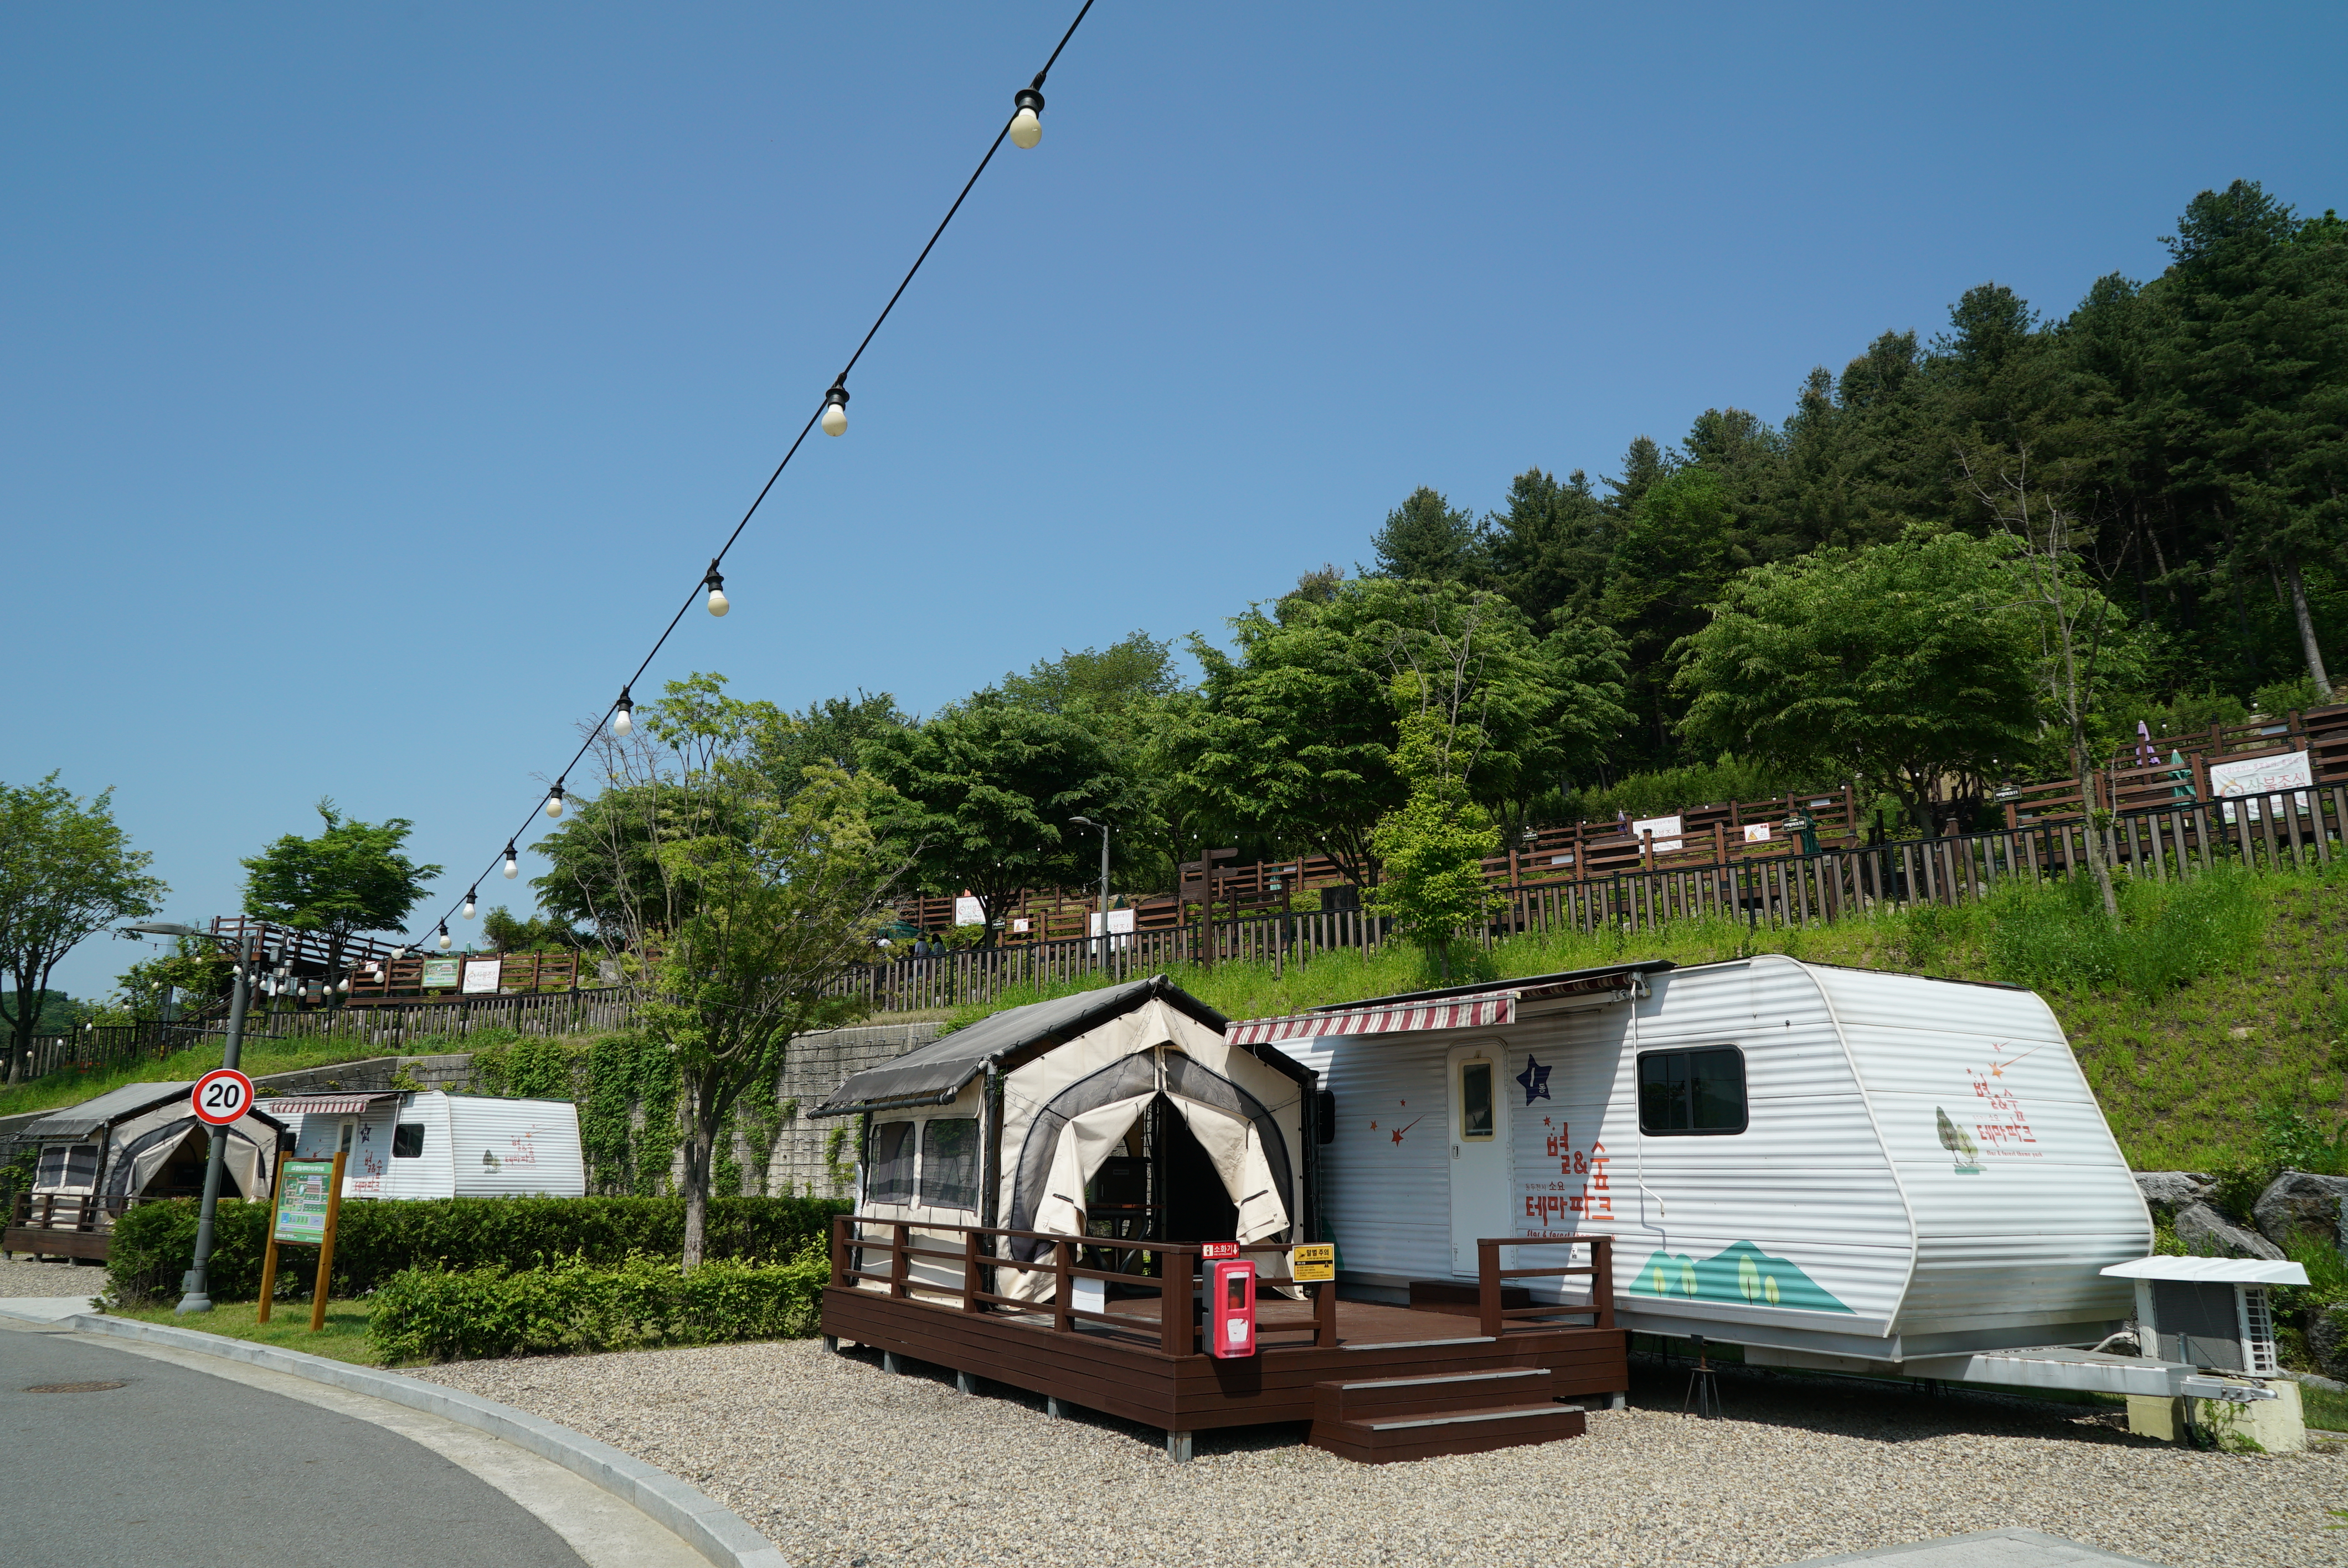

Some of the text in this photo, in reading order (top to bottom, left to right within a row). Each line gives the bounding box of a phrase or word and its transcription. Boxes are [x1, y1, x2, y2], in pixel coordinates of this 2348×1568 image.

[206, 1084, 240, 1108] 20
[1976, 1116, 2037, 1148] 테마파크
[1525, 1181, 1566, 1191] 동두천시 소요
[1526, 1183, 1615, 1227] 테마파크
[1213, 1244, 1233, 1254] 소화기
